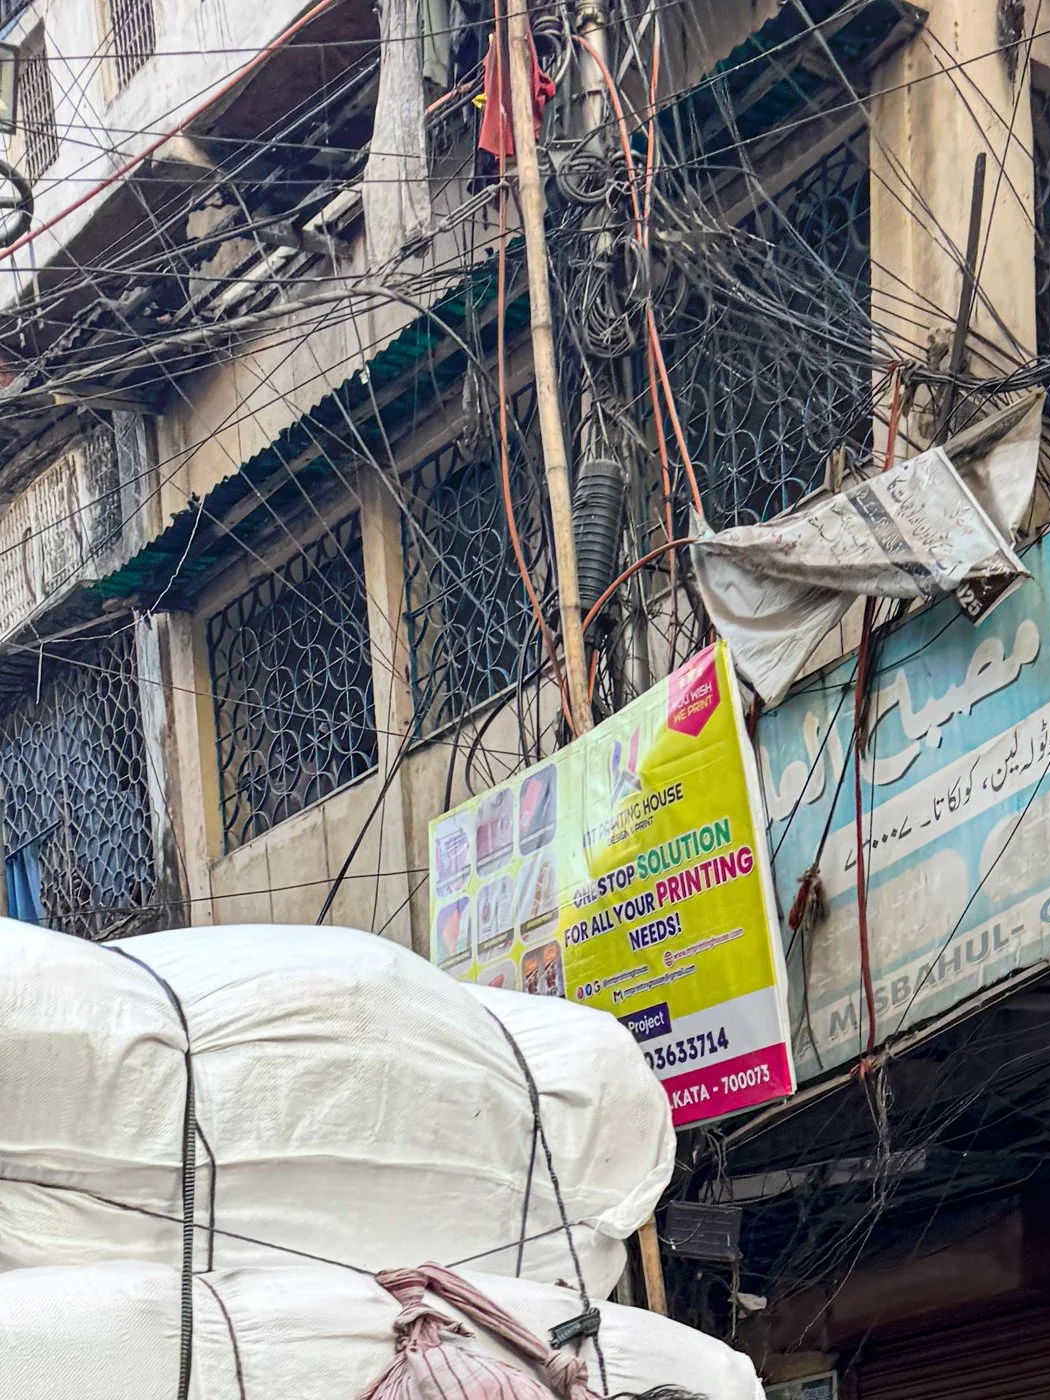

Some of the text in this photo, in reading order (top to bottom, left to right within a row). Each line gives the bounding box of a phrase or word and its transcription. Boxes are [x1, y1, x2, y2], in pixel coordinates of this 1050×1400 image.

[689, 681, 713, 700] WISH
[689, 696, 713, 719] PRINT
[643, 782, 684, 814] HOUSE
[573, 817, 731, 909] ONE STOP SOLUTION
[564, 846, 754, 949] FOR ALL YOUR PRINTING
[629, 912, 683, 952] NEEDS!
[628, 1010, 665, 1034] Project
[671, 1084, 711, 1110] KATA
[721, 1063, 770, 1095] 700073
